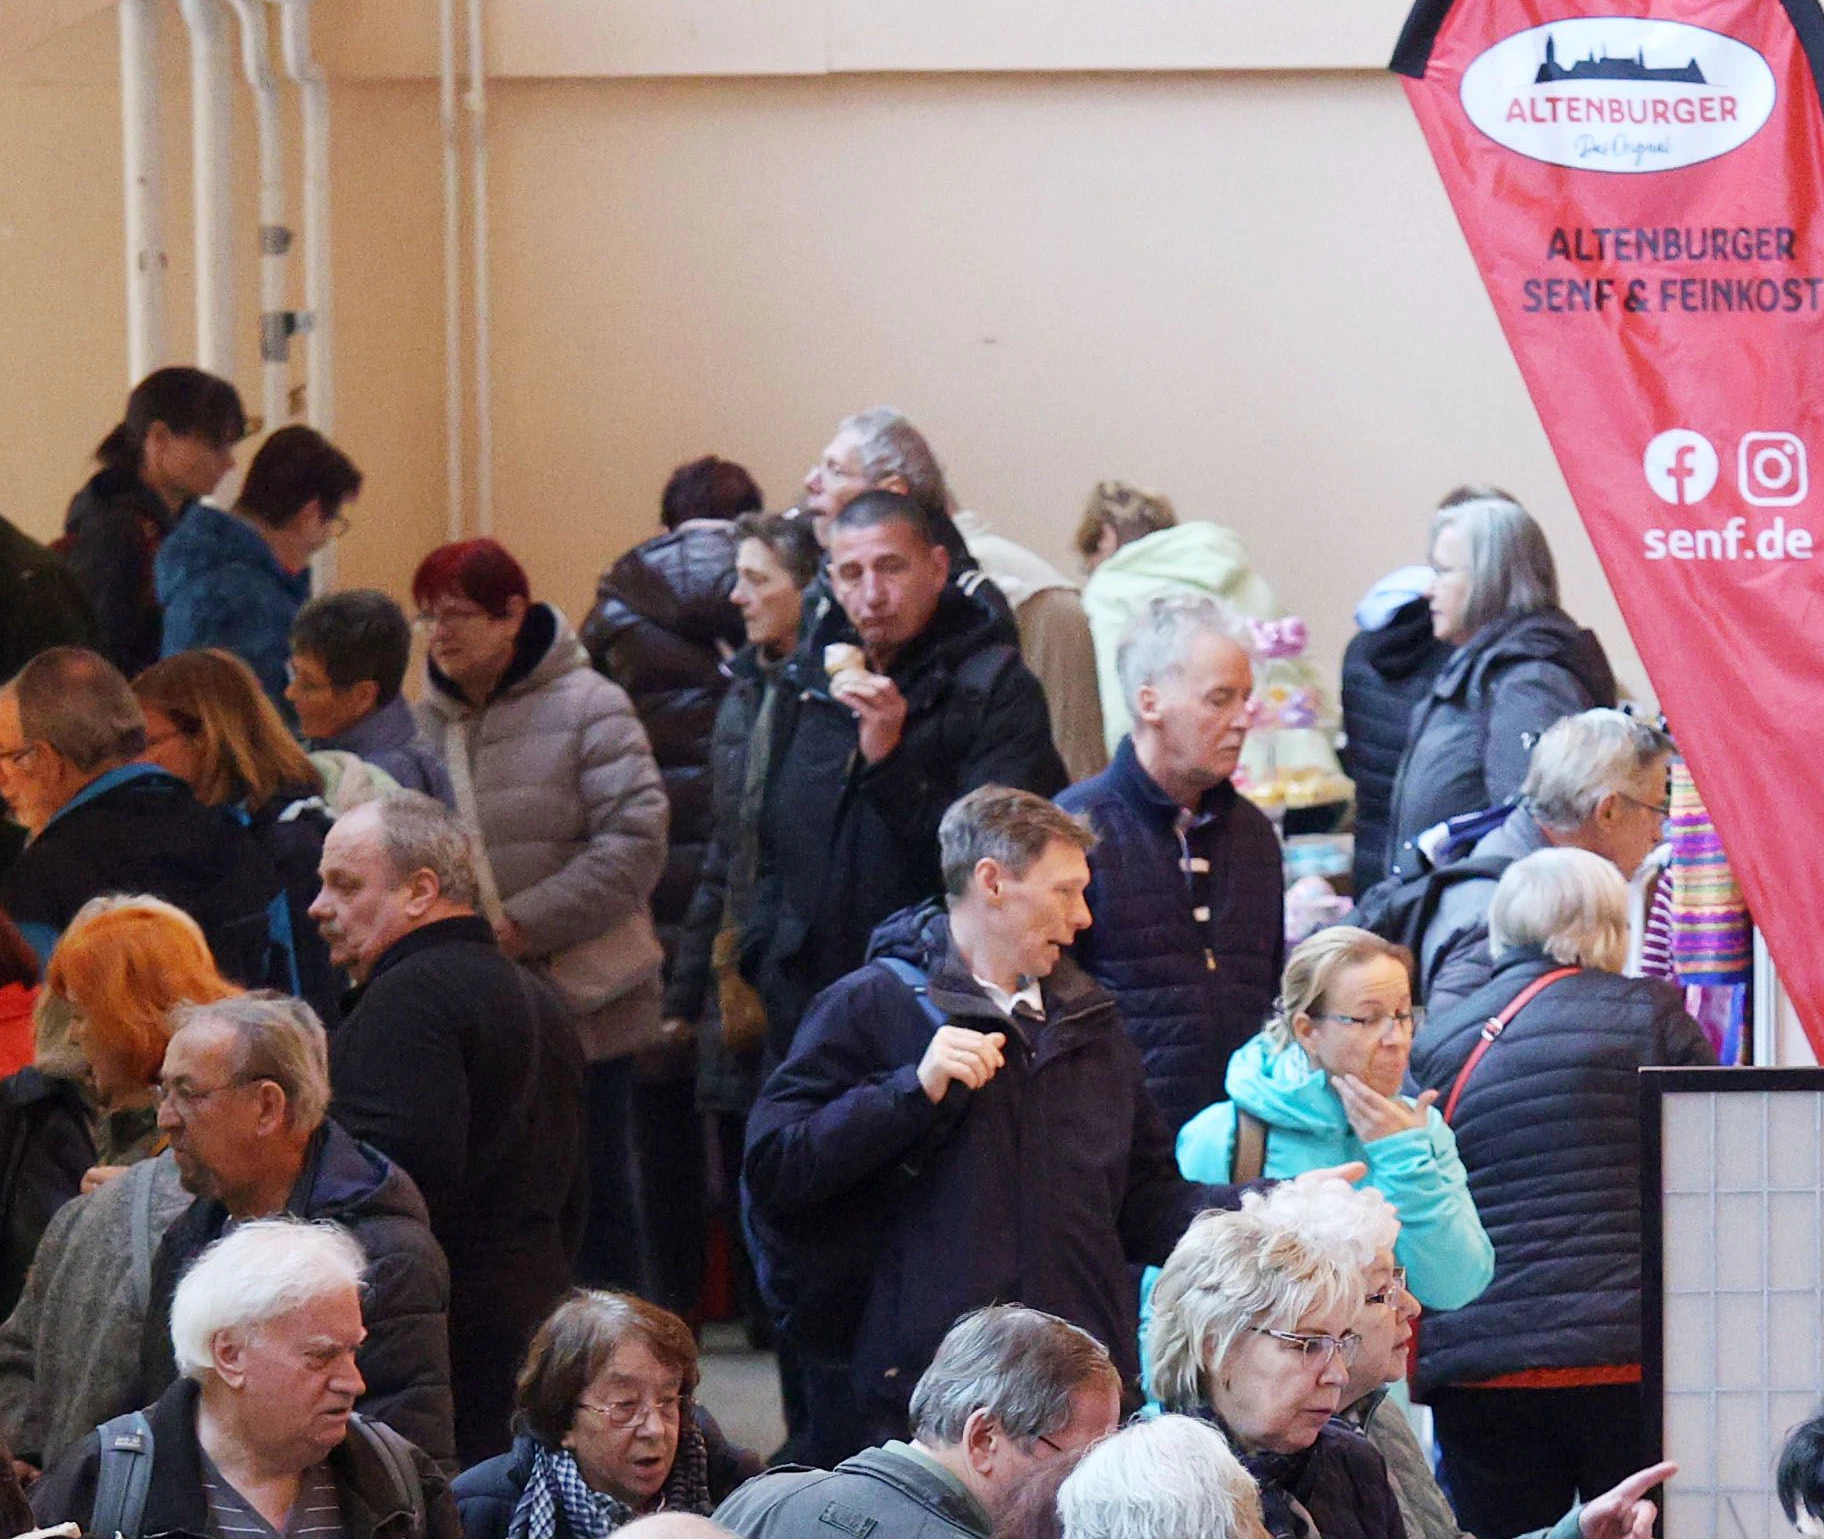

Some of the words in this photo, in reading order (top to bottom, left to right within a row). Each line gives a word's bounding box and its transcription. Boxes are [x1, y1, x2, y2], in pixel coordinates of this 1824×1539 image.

[1505, 95, 1738, 125] ALTENBURGER
[1547, 228, 1796, 262] ALTENBURGER
[1522, 278, 1614, 313] SENF
[1624, 279, 1650, 313] &
[1660, 278, 1824, 313] FEINKOST
[1643, 517, 1813, 561] senf.de
